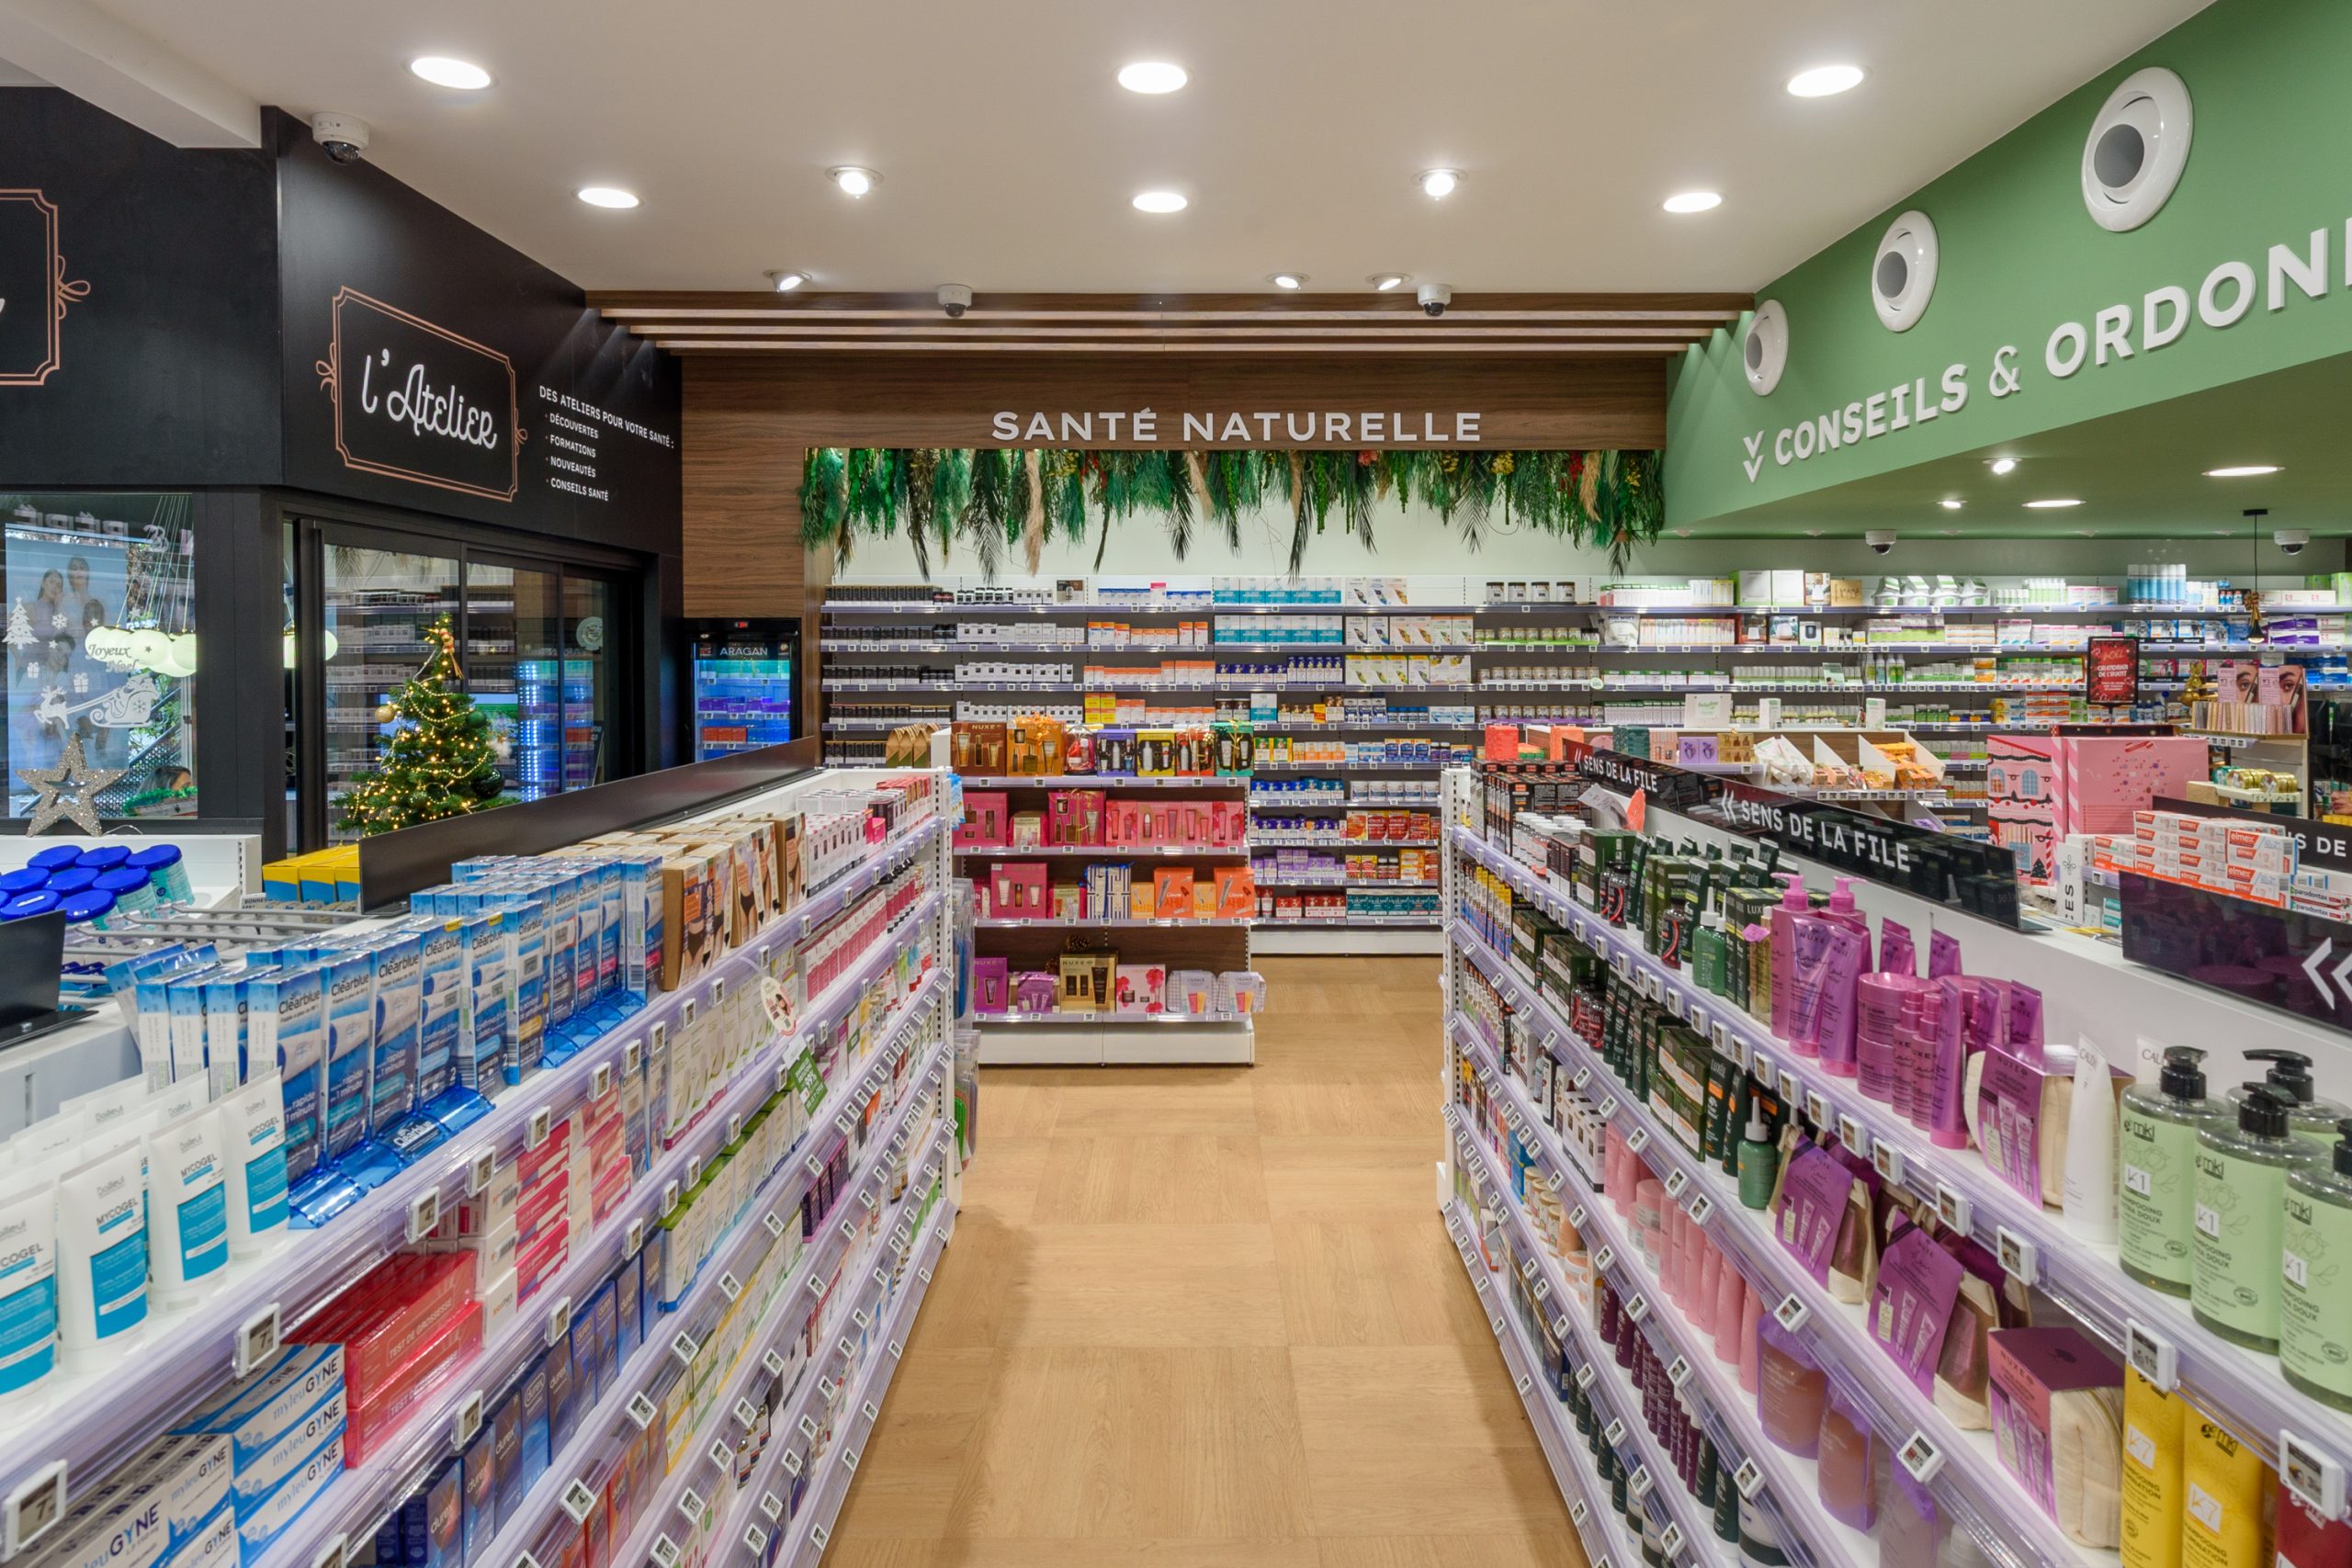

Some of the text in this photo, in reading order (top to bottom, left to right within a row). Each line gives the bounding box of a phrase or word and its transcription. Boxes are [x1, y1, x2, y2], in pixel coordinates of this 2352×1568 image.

[1775, 217, 2352, 466] CONSEILS & ORDON
[539, 386, 558, 403] DES
[560, 391, 601, 420] ATELIERS
[603, 407, 623, 430] POUR
[625, 416, 647, 439] VOTRE
[649, 424, 671, 448] SANTÉ
[549, 412, 599, 439] DÉCOUVERTES
[992, 407, 1481, 442] SANTÉ NATURELLE
[550, 434, 596, 458] FORMATIONS
[550, 456, 596, 478] NOUVEAUTÉS
[550, 478, 608, 502] CONSEILS SANTÉ
[87, 644, 132, 660] Joyeux
[720, 647, 768, 656] ARAGAN
[1583, 754, 1658, 794] SENS DE LA FILE
[1740, 799, 1911, 874] SENS DE LA FILE
[2231, 832, 2255, 843] elmex
[2316, 836, 2346, 857] DE
[2228, 866, 2251, 878] elmex
[2293, 888, 2328, 901] parodontax
[2296, 905, 2329, 917] parodontax
[424, 935, 460, 957] Clearblue
[471, 930, 503, 951] Clearblue
[379, 954, 419, 978] Clearblue
[331, 973, 368, 997] Clearblue
[278, 990, 320, 1015] Clearblue
[247, 1116, 279, 1139] MYCOGEL
[180, 1153, 218, 1178] MYCOGEL
[96, 1197, 139, 1225] MYCOGEL
[0, 1242, 44, 1268] COGEL
[389, 1341, 406, 1359] TEST
[272, 1356, 340, 1421] myleuGYNE
[272, 1398, 341, 1467] myleuGYNE
[171, 1445, 229, 1502] myleuGYNE
[277, 1440, 340, 1512] myleuGYNE
